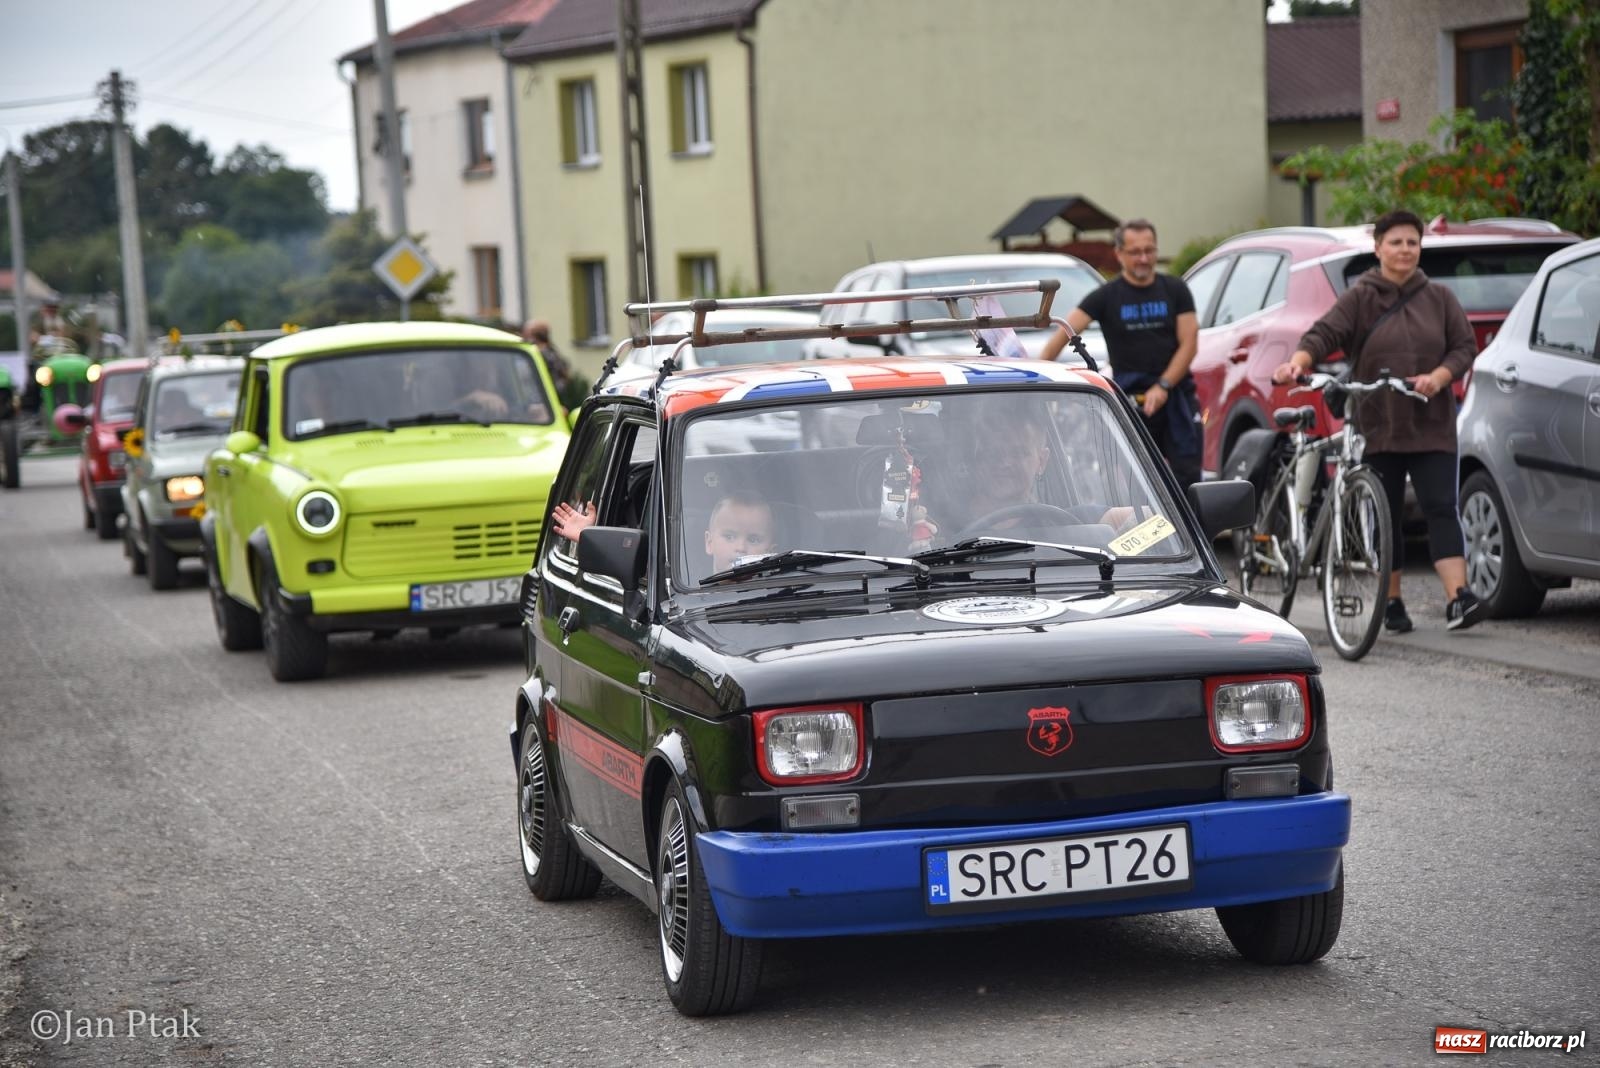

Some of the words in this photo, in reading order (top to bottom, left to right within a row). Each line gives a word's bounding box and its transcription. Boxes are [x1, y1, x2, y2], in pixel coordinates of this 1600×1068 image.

[1141, 301, 1168, 317] STAR
[1121, 536, 1141, 552] 070
[424, 582, 473, 609] SRC
[1032, 711, 1067, 719] ABARTH
[602, 751, 637, 786] ABARTH
[958, 848, 1048, 897] SRC
[1064, 834, 1176, 889] PT26
[931, 885, 947, 897] PL
